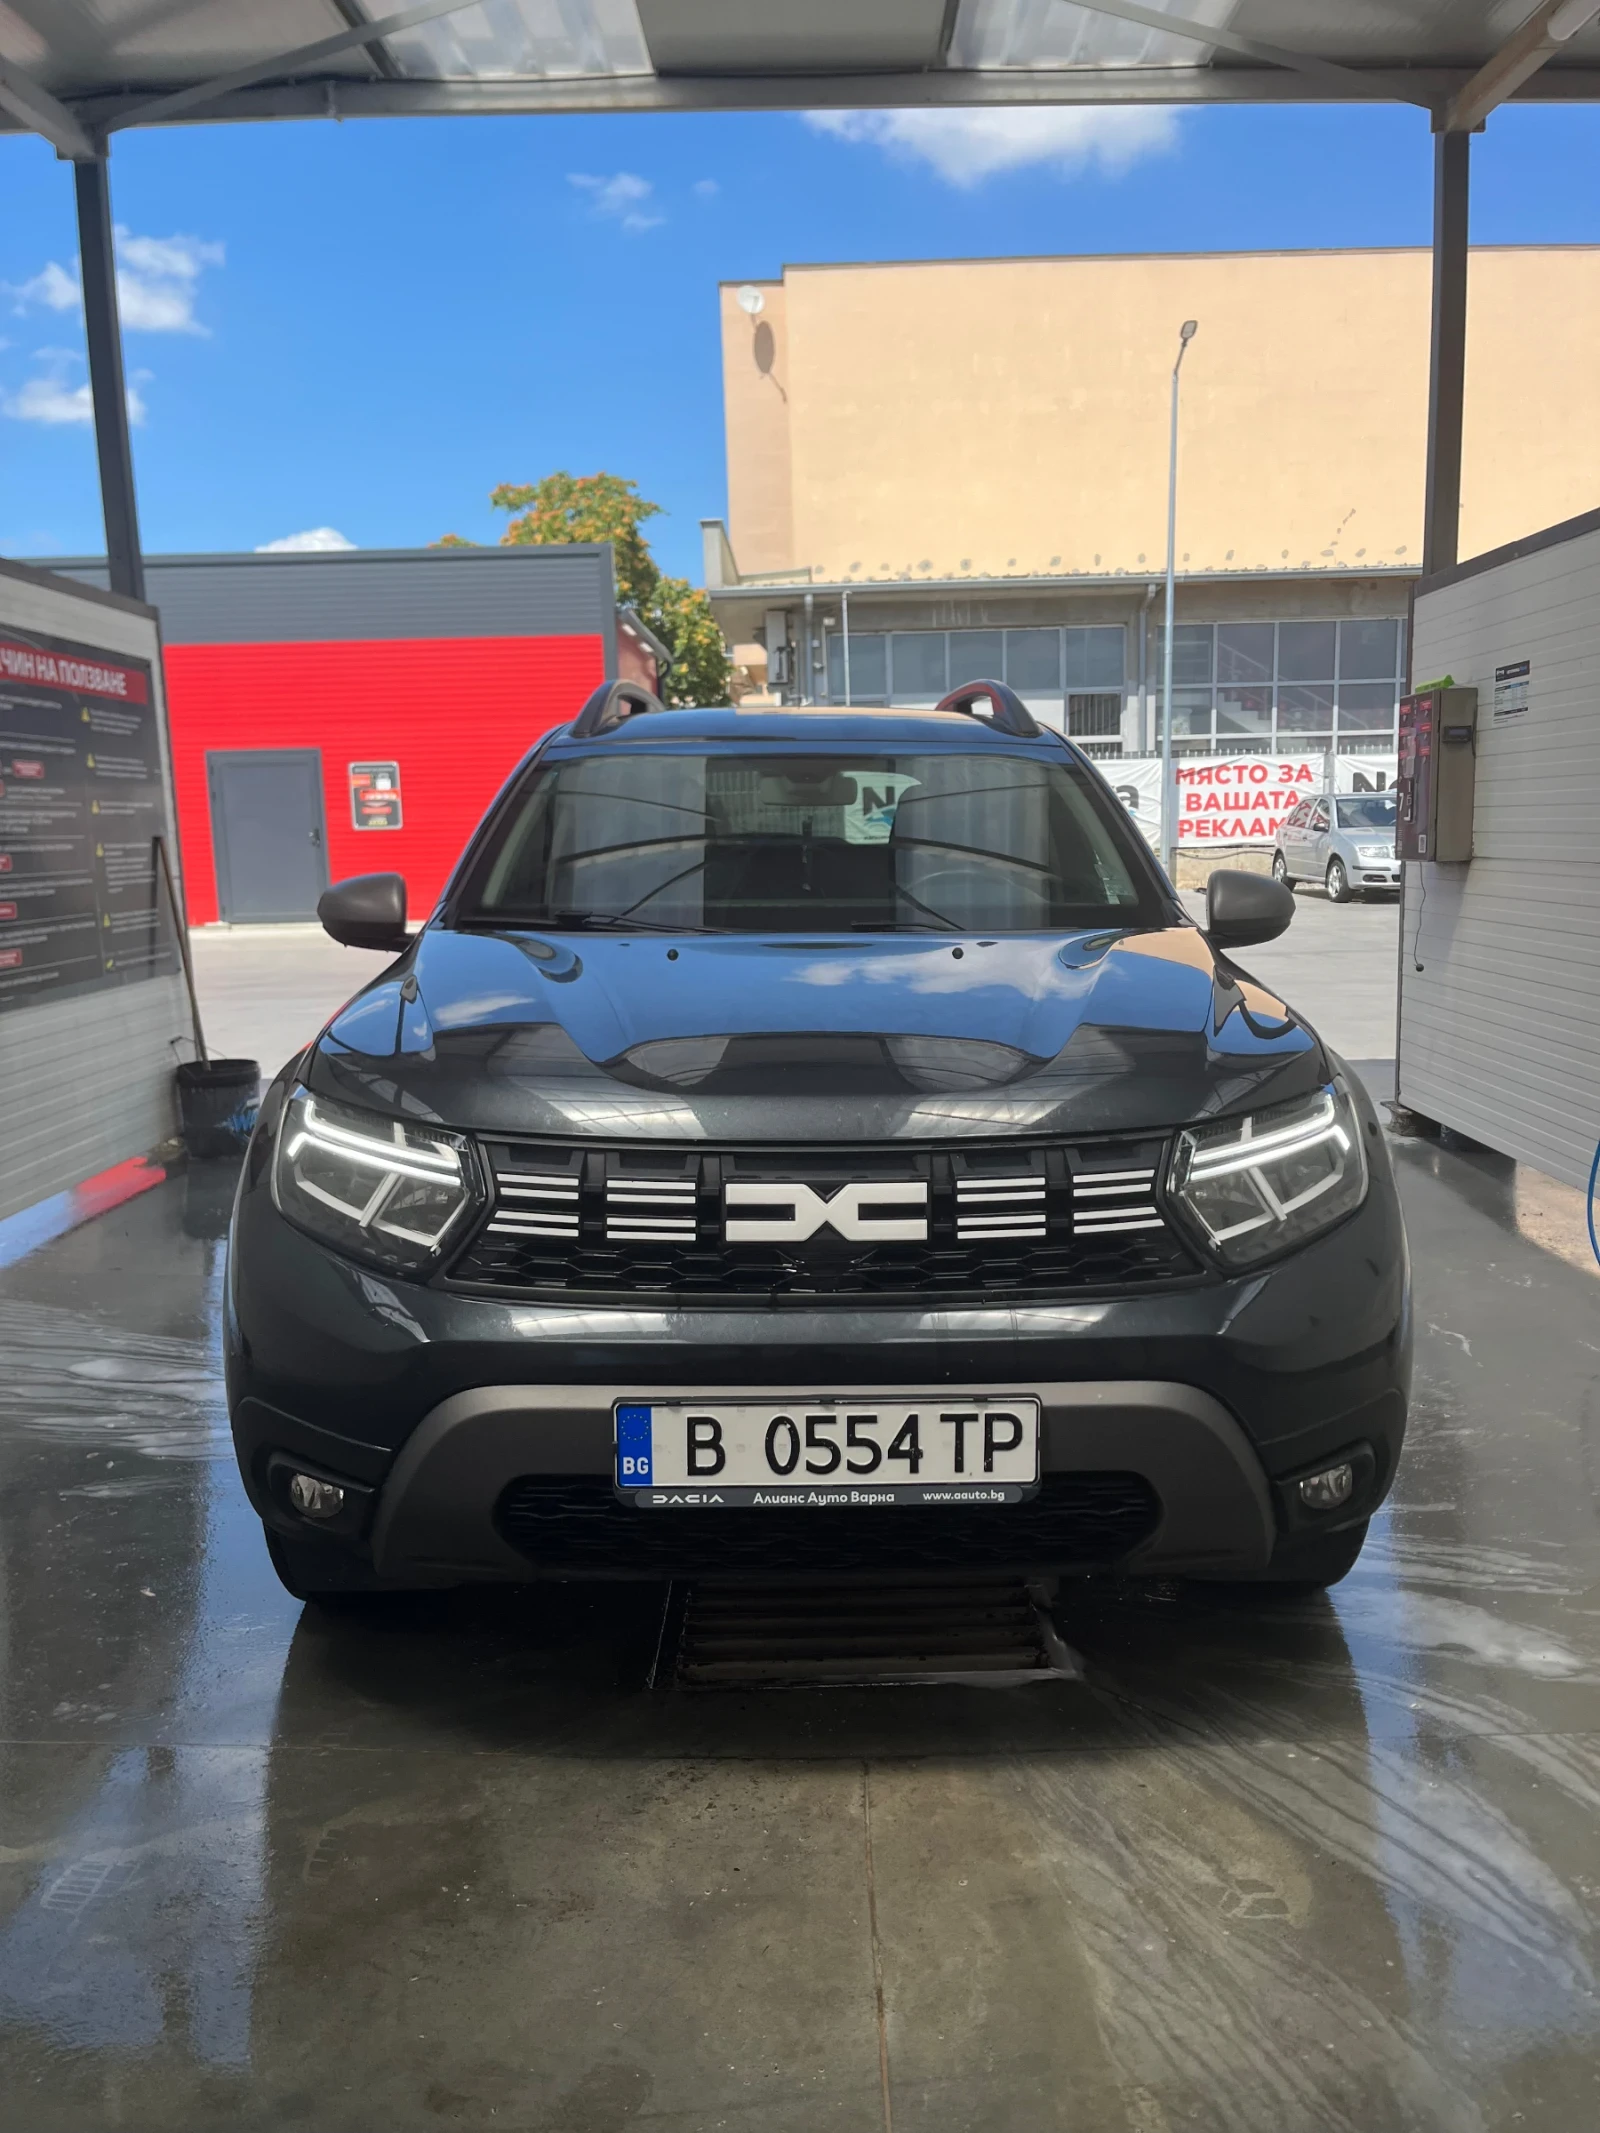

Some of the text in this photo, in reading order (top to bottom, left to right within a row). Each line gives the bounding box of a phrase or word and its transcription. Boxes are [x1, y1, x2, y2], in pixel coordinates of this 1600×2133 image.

[0, 647, 35, 679] ЧИН
[36, 655, 58, 682] НА
[1175, 764, 1313, 785] МЯСТО ЗА
[1186, 790, 1300, 812] ВАШАТА
[1177, 817, 1288, 838] РЕКЛАМ
[686, 1412, 1023, 1476] B 0554 TP
[622, 1458, 649, 1475] BG
[652, 1494, 725, 1504] DACIA
[753, 1492, 805, 1504] Алианс
[850, 1491, 895, 1505] Варна
[922, 1489, 1005, 1502] www.aauto.bg
